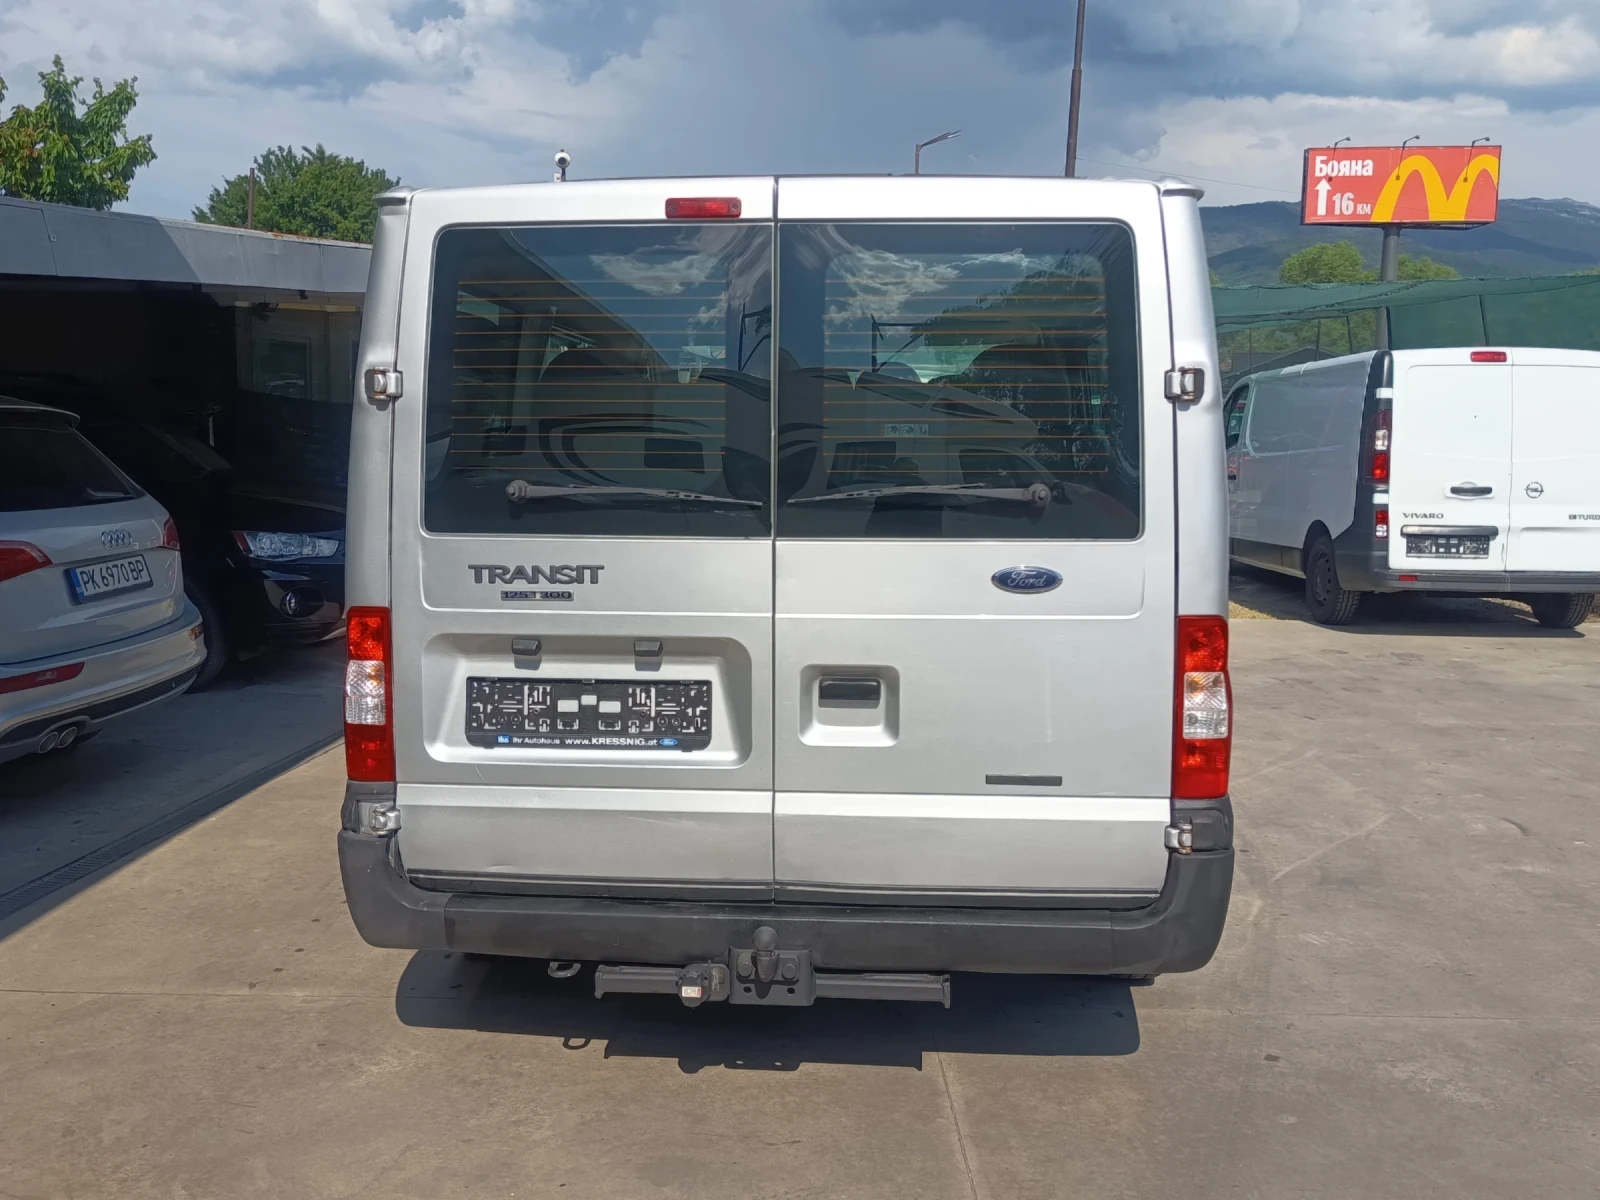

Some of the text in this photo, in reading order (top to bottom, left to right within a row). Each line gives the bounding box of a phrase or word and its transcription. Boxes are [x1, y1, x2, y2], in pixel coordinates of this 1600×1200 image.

[1314, 155, 1374, 177] Бояна
[1332, 192, 1355, 216] 16
[468, 564, 605, 584] TRANSIT
[1007, 570, 1047, 587] Ford
[523, 737, 560, 745] Autohaus
[564, 737, 658, 746] www.KRESSNIG.at
